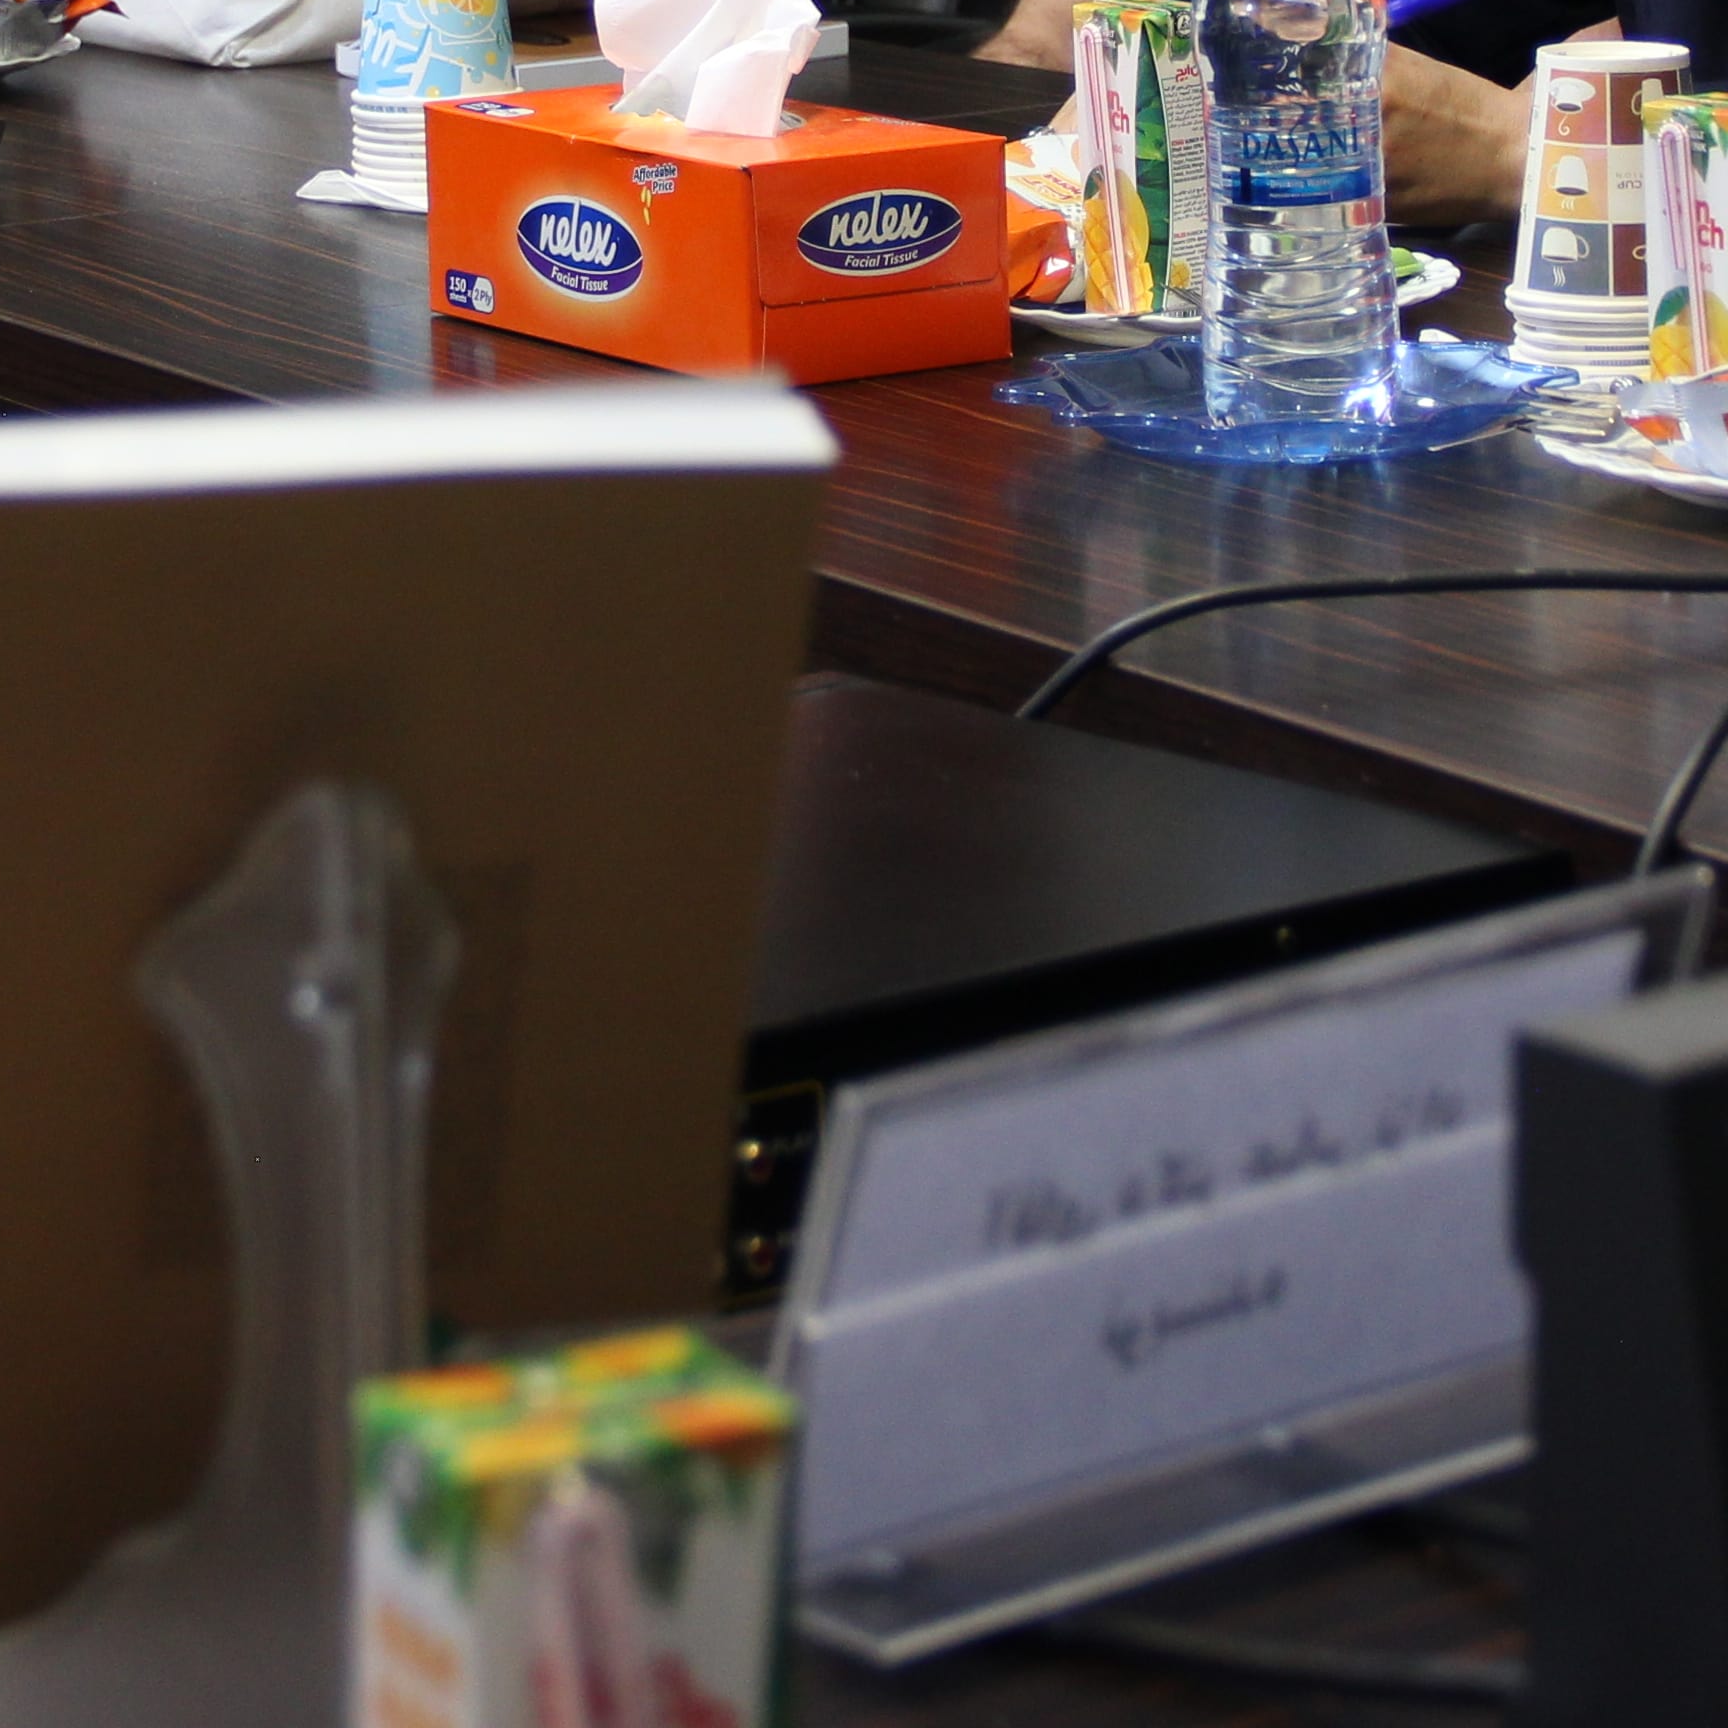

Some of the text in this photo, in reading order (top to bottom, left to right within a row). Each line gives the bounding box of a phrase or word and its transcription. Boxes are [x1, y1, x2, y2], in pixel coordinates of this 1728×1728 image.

[1240, 123, 1359, 167] DASANI
[632, 164, 677, 183] Affordable
[652, 180, 674, 193] Price
[829, 192, 929, 248] nelex
[539, 200, 617, 267] nelex
[844, 248, 919, 269] Facial Tissue
[449, 276, 467, 293] 150
[551, 266, 608, 292] Facial Tissue
